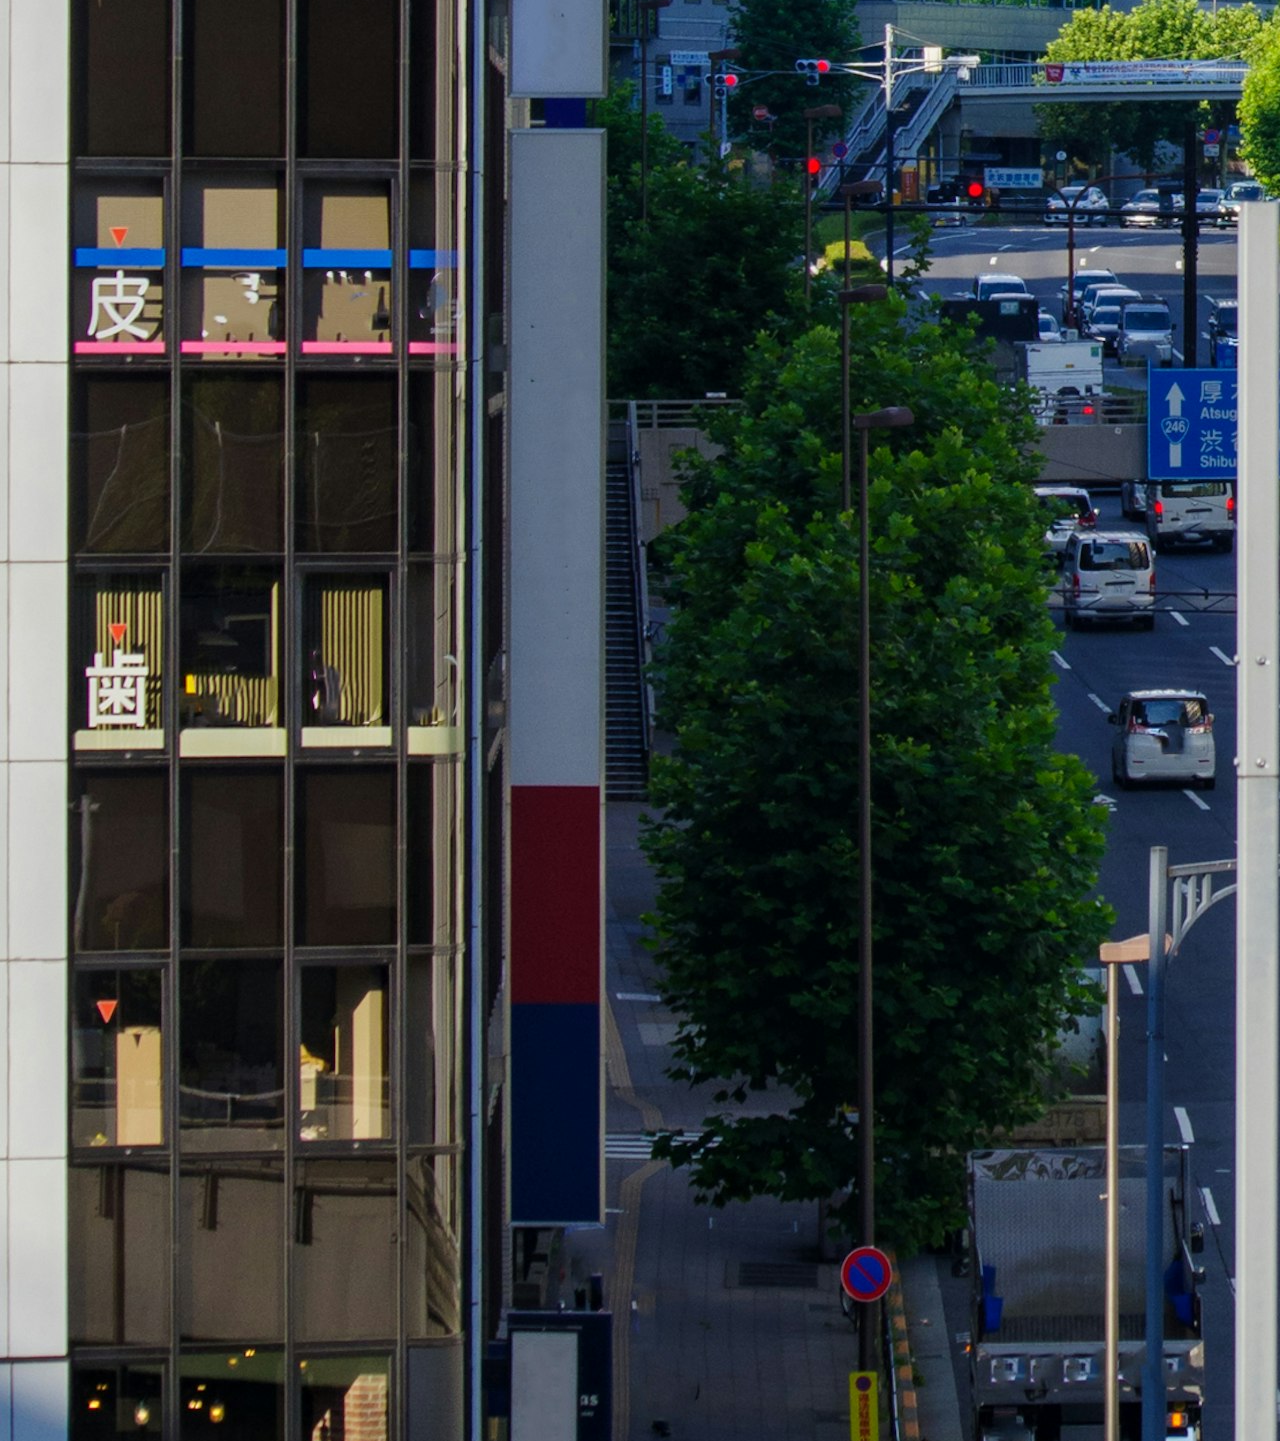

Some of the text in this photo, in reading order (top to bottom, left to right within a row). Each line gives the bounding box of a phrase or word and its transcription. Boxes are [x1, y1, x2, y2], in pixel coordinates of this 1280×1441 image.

[86, 270, 151, 340] 皮
[1200, 380, 1238, 404] 厚
[1165, 421, 1186, 433] 246
[85, 650, 149, 728] 歯
